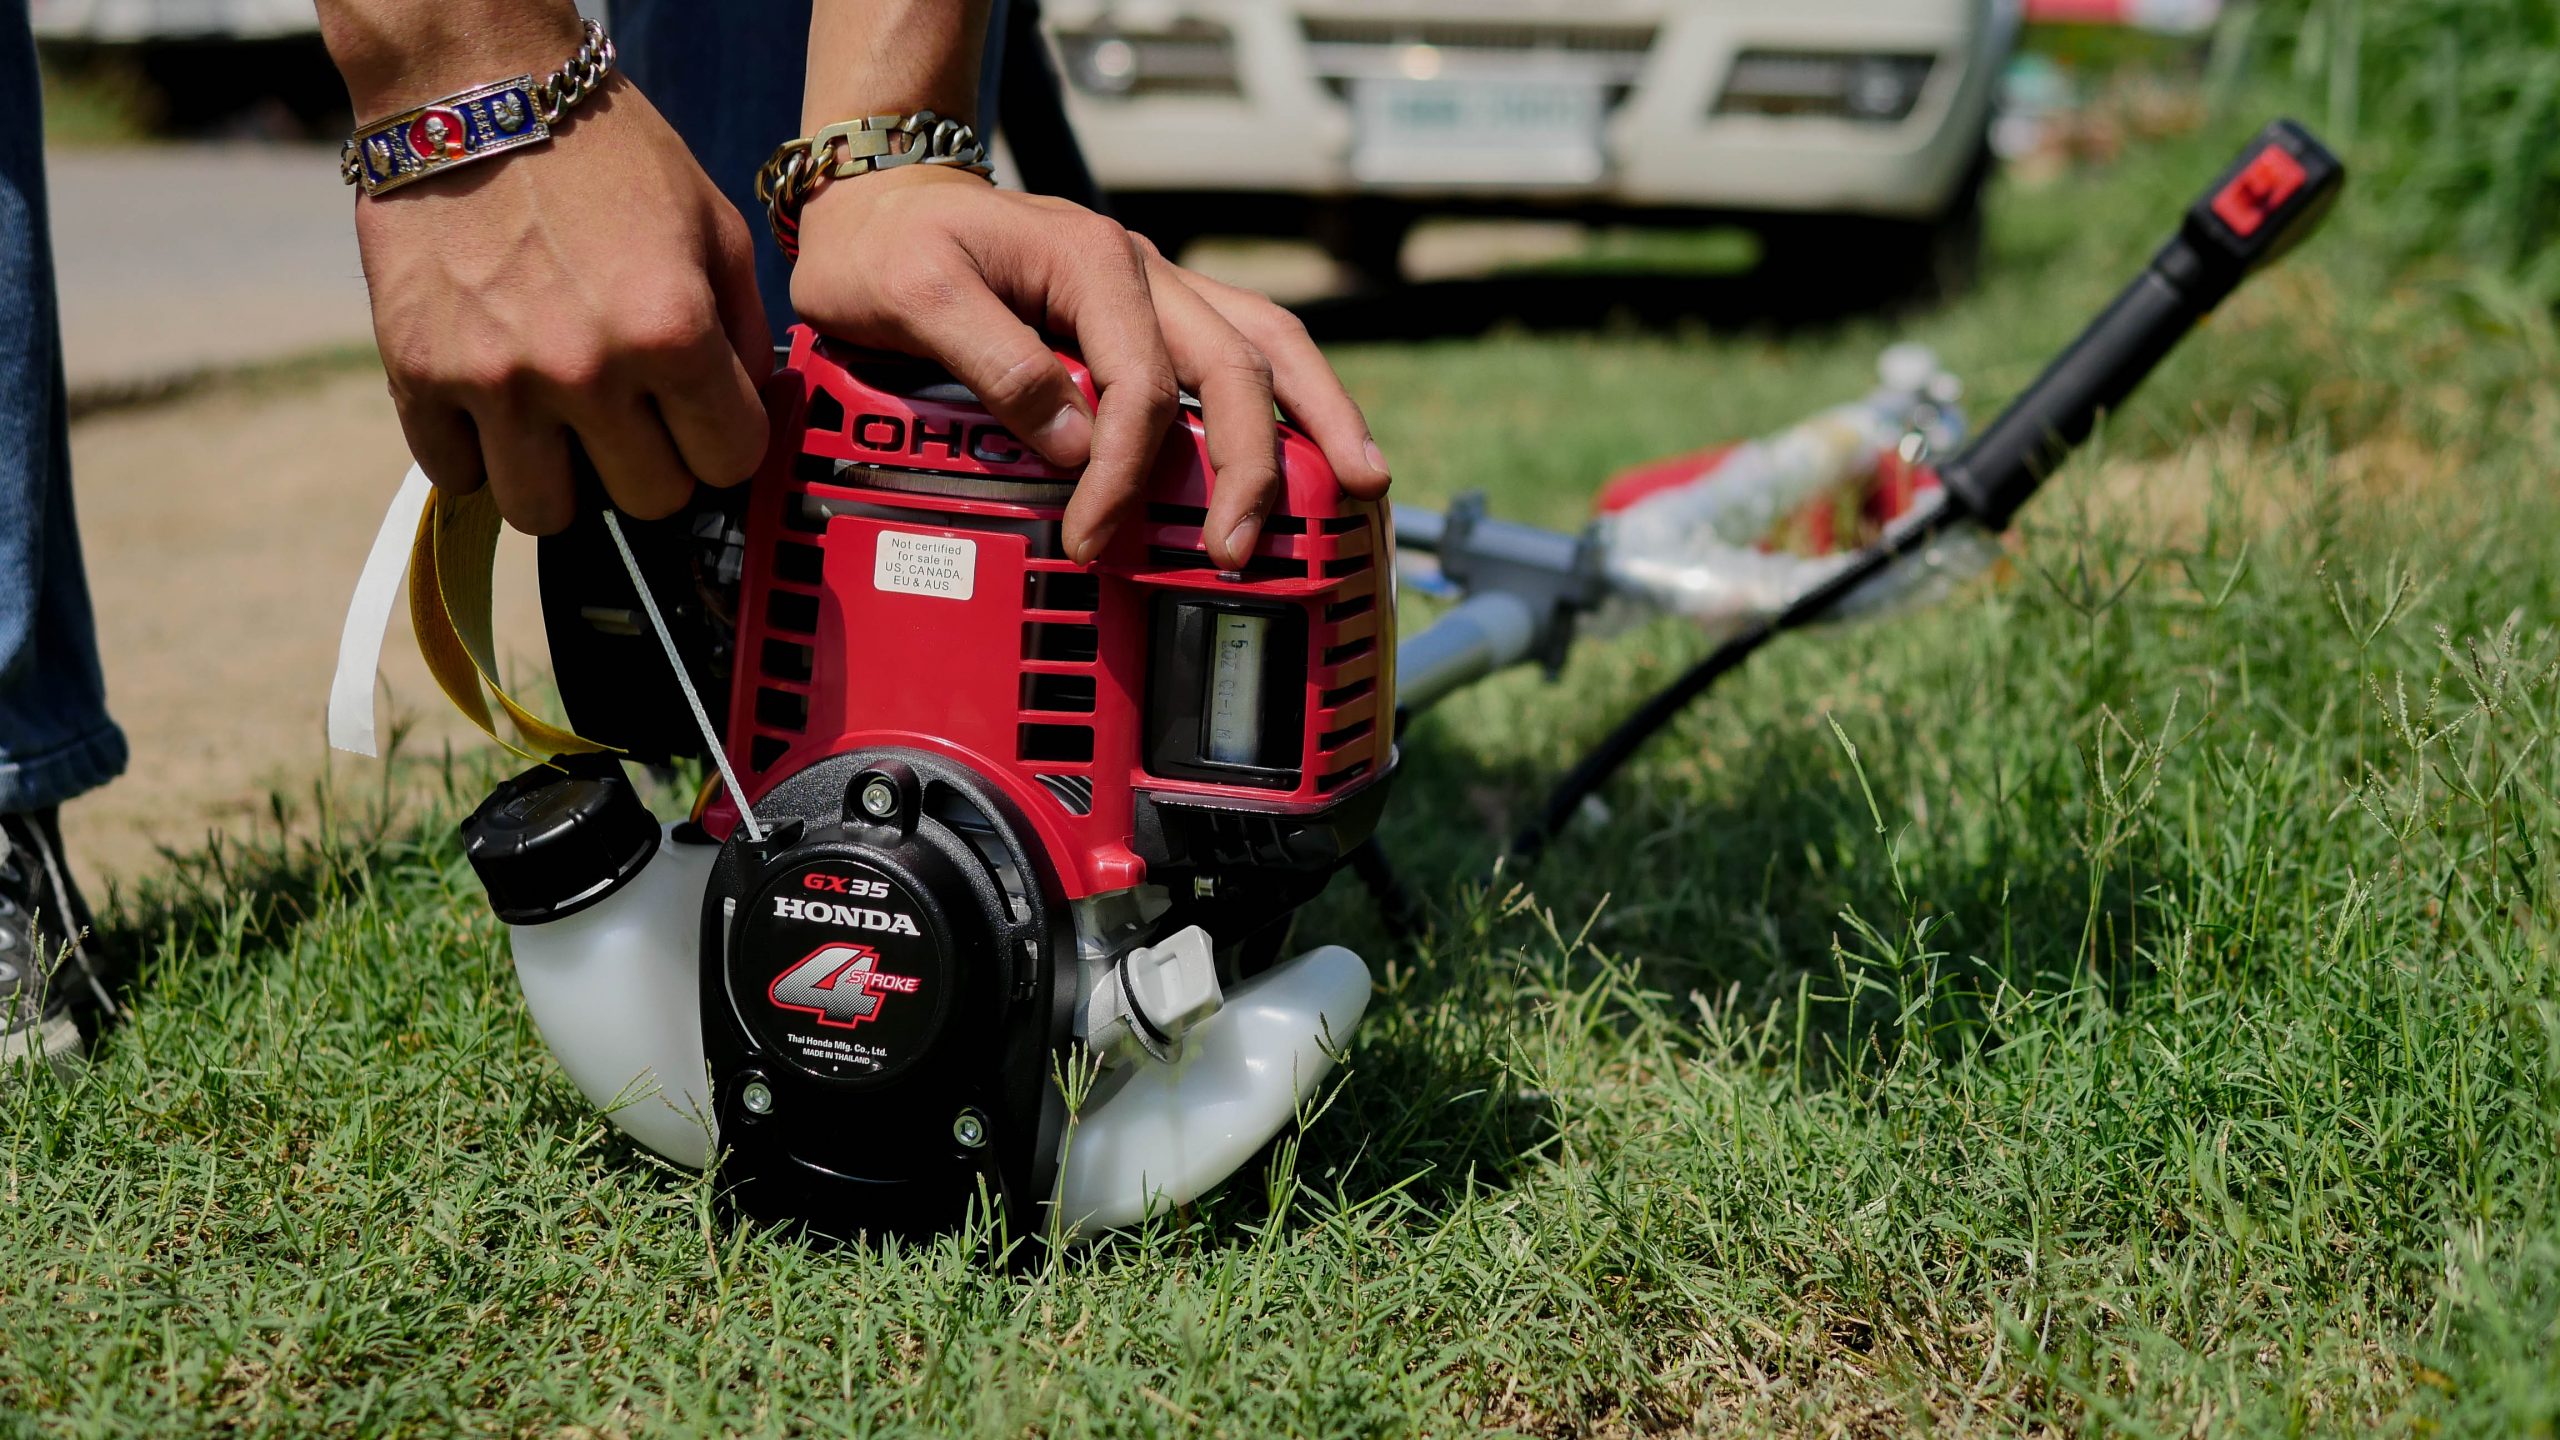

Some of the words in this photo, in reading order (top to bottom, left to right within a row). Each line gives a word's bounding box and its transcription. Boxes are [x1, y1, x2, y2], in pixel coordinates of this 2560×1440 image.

[851, 413, 1021, 463] OHC
[892, 538, 911, 549] Not
[915, 542, 962, 556] certified
[898, 551, 914, 562] for
[917, 553, 940, 565] sale
[943, 556, 954, 567] in
[885, 562, 905, 575] US,
[909, 565, 964, 581] CANADA,
[893, 575, 910, 586] EU
[912, 577, 920, 587] &
[803, 872, 891, 899] GX35
[772, 896, 921, 937] HONDA
[767, 941, 887, 1030] 4
[847, 969, 922, 993] STROKE
[787, 1033, 806, 1045] Thai
[806, 1036, 833, 1048] Honda
[834, 1040, 853, 1052] Mfg.
[854, 1043, 870, 1055] Co.,
[871, 1046, 888, 1057] Ltd.
[802, 1047, 824, 1058] MADE
[825, 1050, 834, 1059] IN
[834, 1052, 871, 1065] THAILAND
